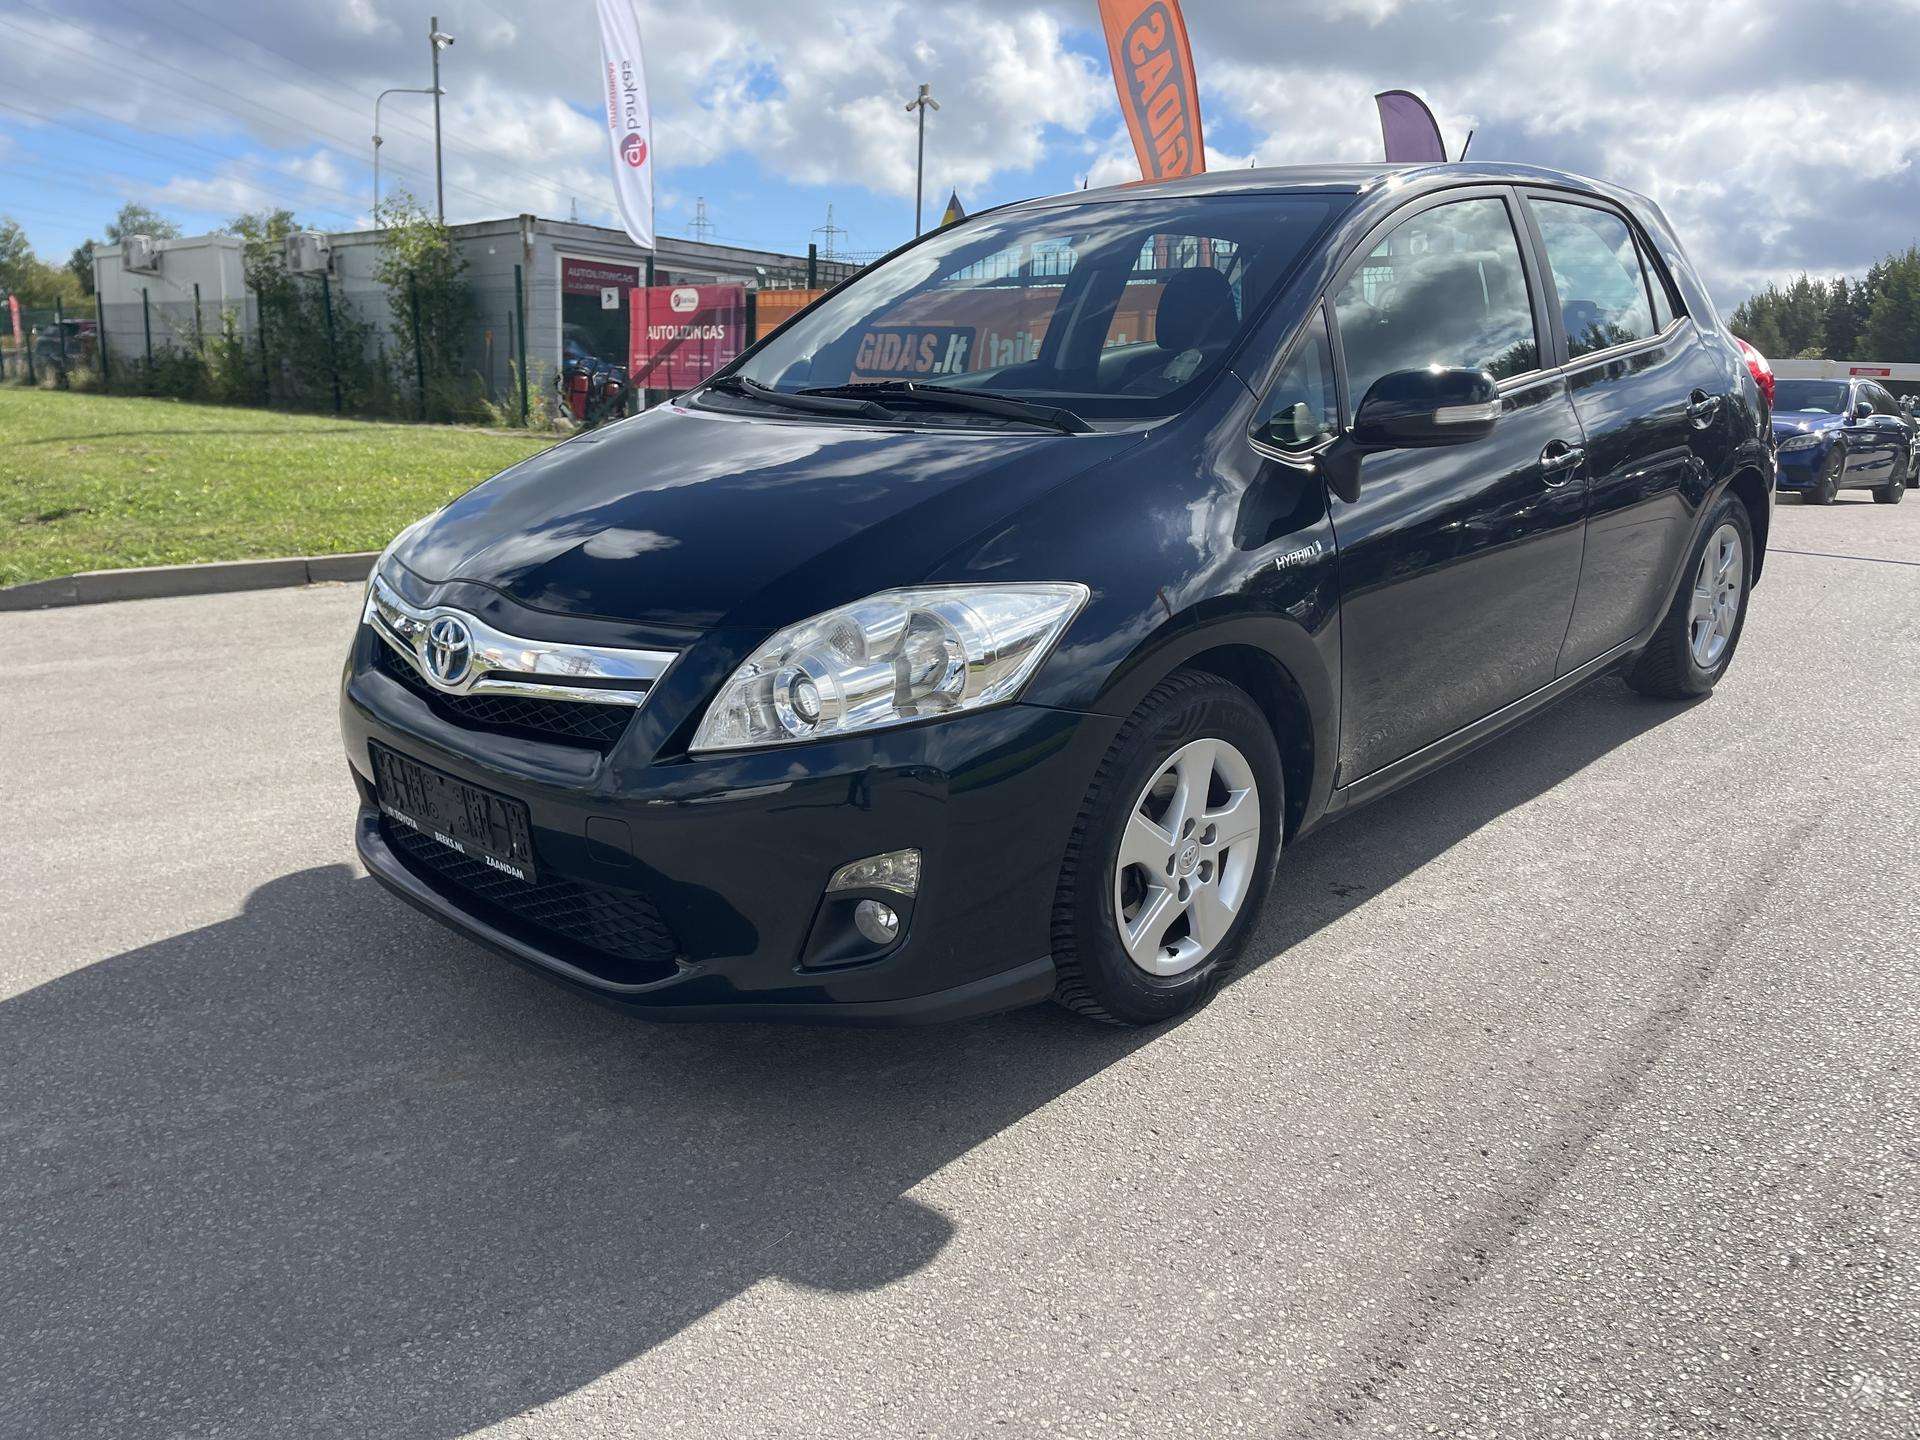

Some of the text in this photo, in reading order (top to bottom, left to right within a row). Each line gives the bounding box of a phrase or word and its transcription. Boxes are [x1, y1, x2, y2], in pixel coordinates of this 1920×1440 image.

[646, 324, 725, 340] AUTOLIZINGAS
[856, 333, 968, 374] GIDAS.lt
[1275, 545, 1315, 570] HYBRID
[485, 855, 524, 880] ZAANDAM
